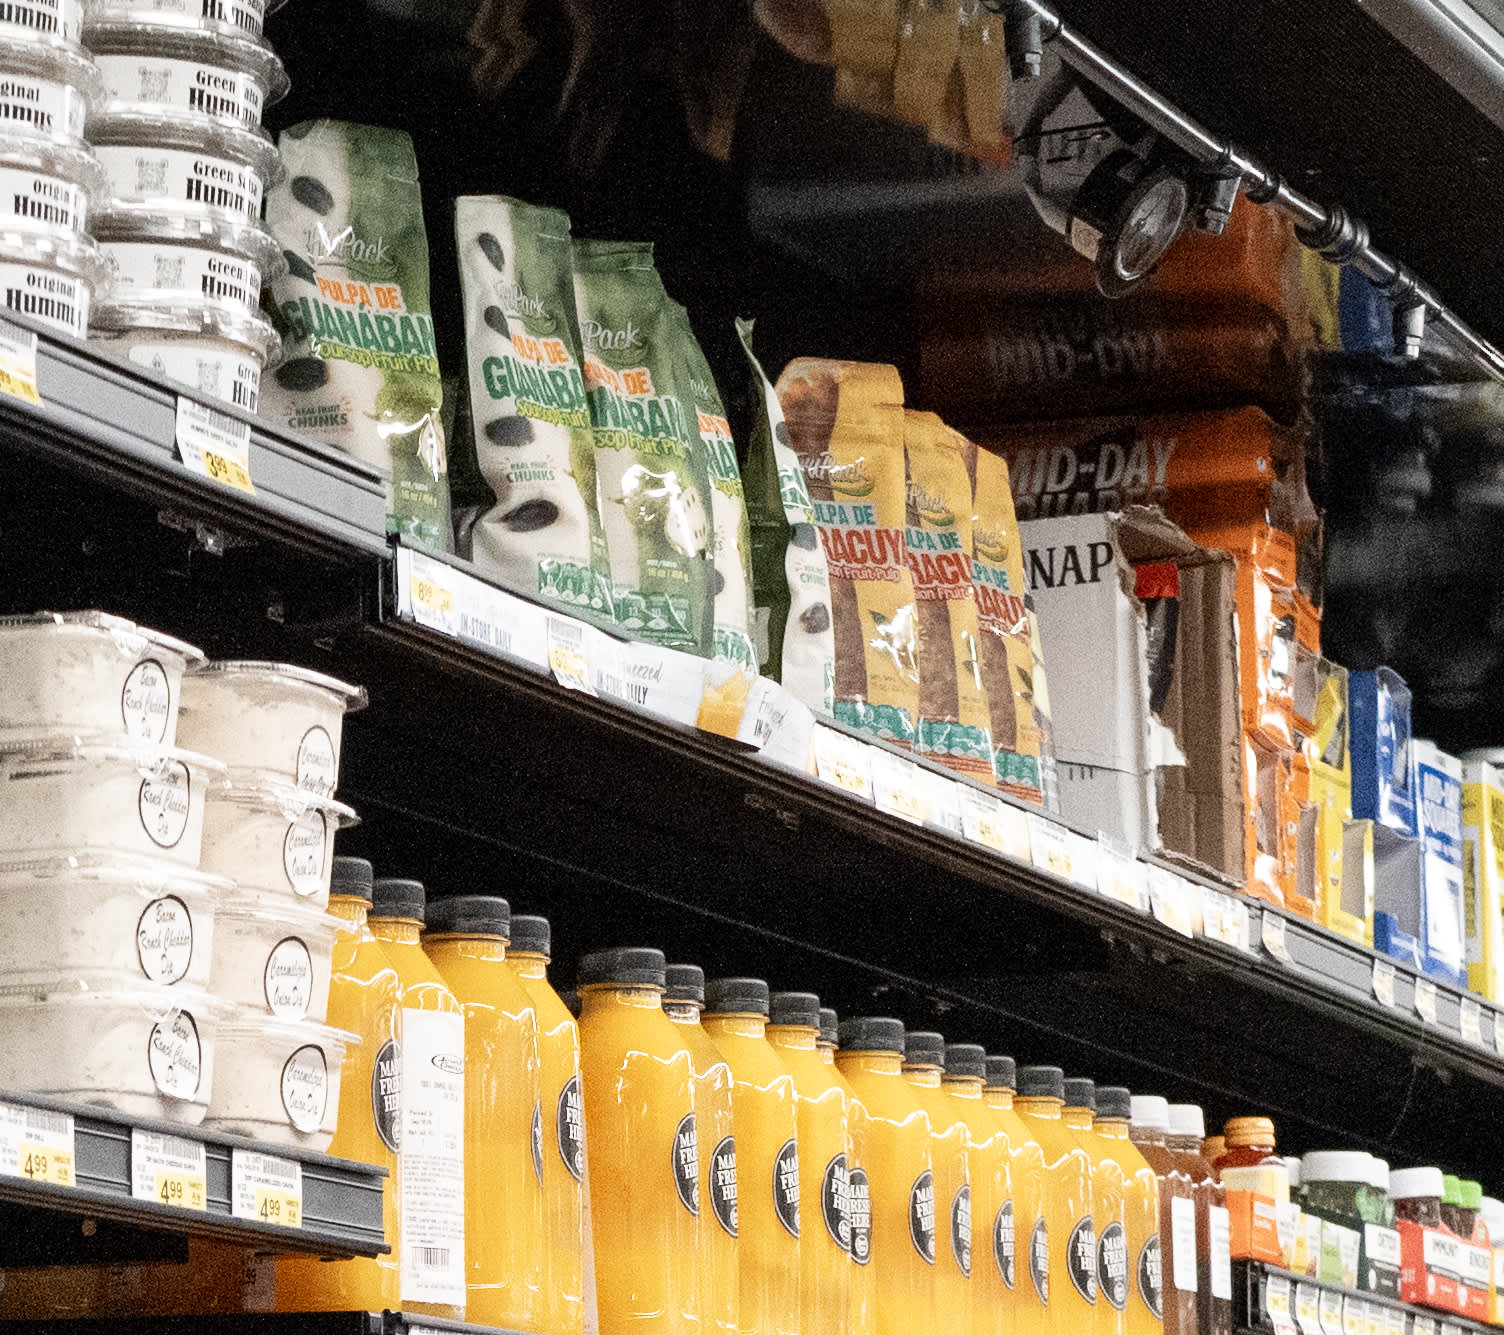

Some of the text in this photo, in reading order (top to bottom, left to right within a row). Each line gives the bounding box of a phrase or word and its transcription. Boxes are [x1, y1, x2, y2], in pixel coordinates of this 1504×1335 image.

[196, 69, 238, 94] Green
[193, 159, 236, 184] Green
[207, 256, 244, 284] Green
[26, 271, 77, 299] Original
[319, 276, 401, 310] PULPA DE
[543, 339, 569, 364] DE
[623, 370, 650, 395] DE
[288, 411, 348, 429] CHUNKS
[506, 469, 555, 484] CHUNKS
[853, 503, 875, 526] DE
[939, 530, 960, 550] DE
